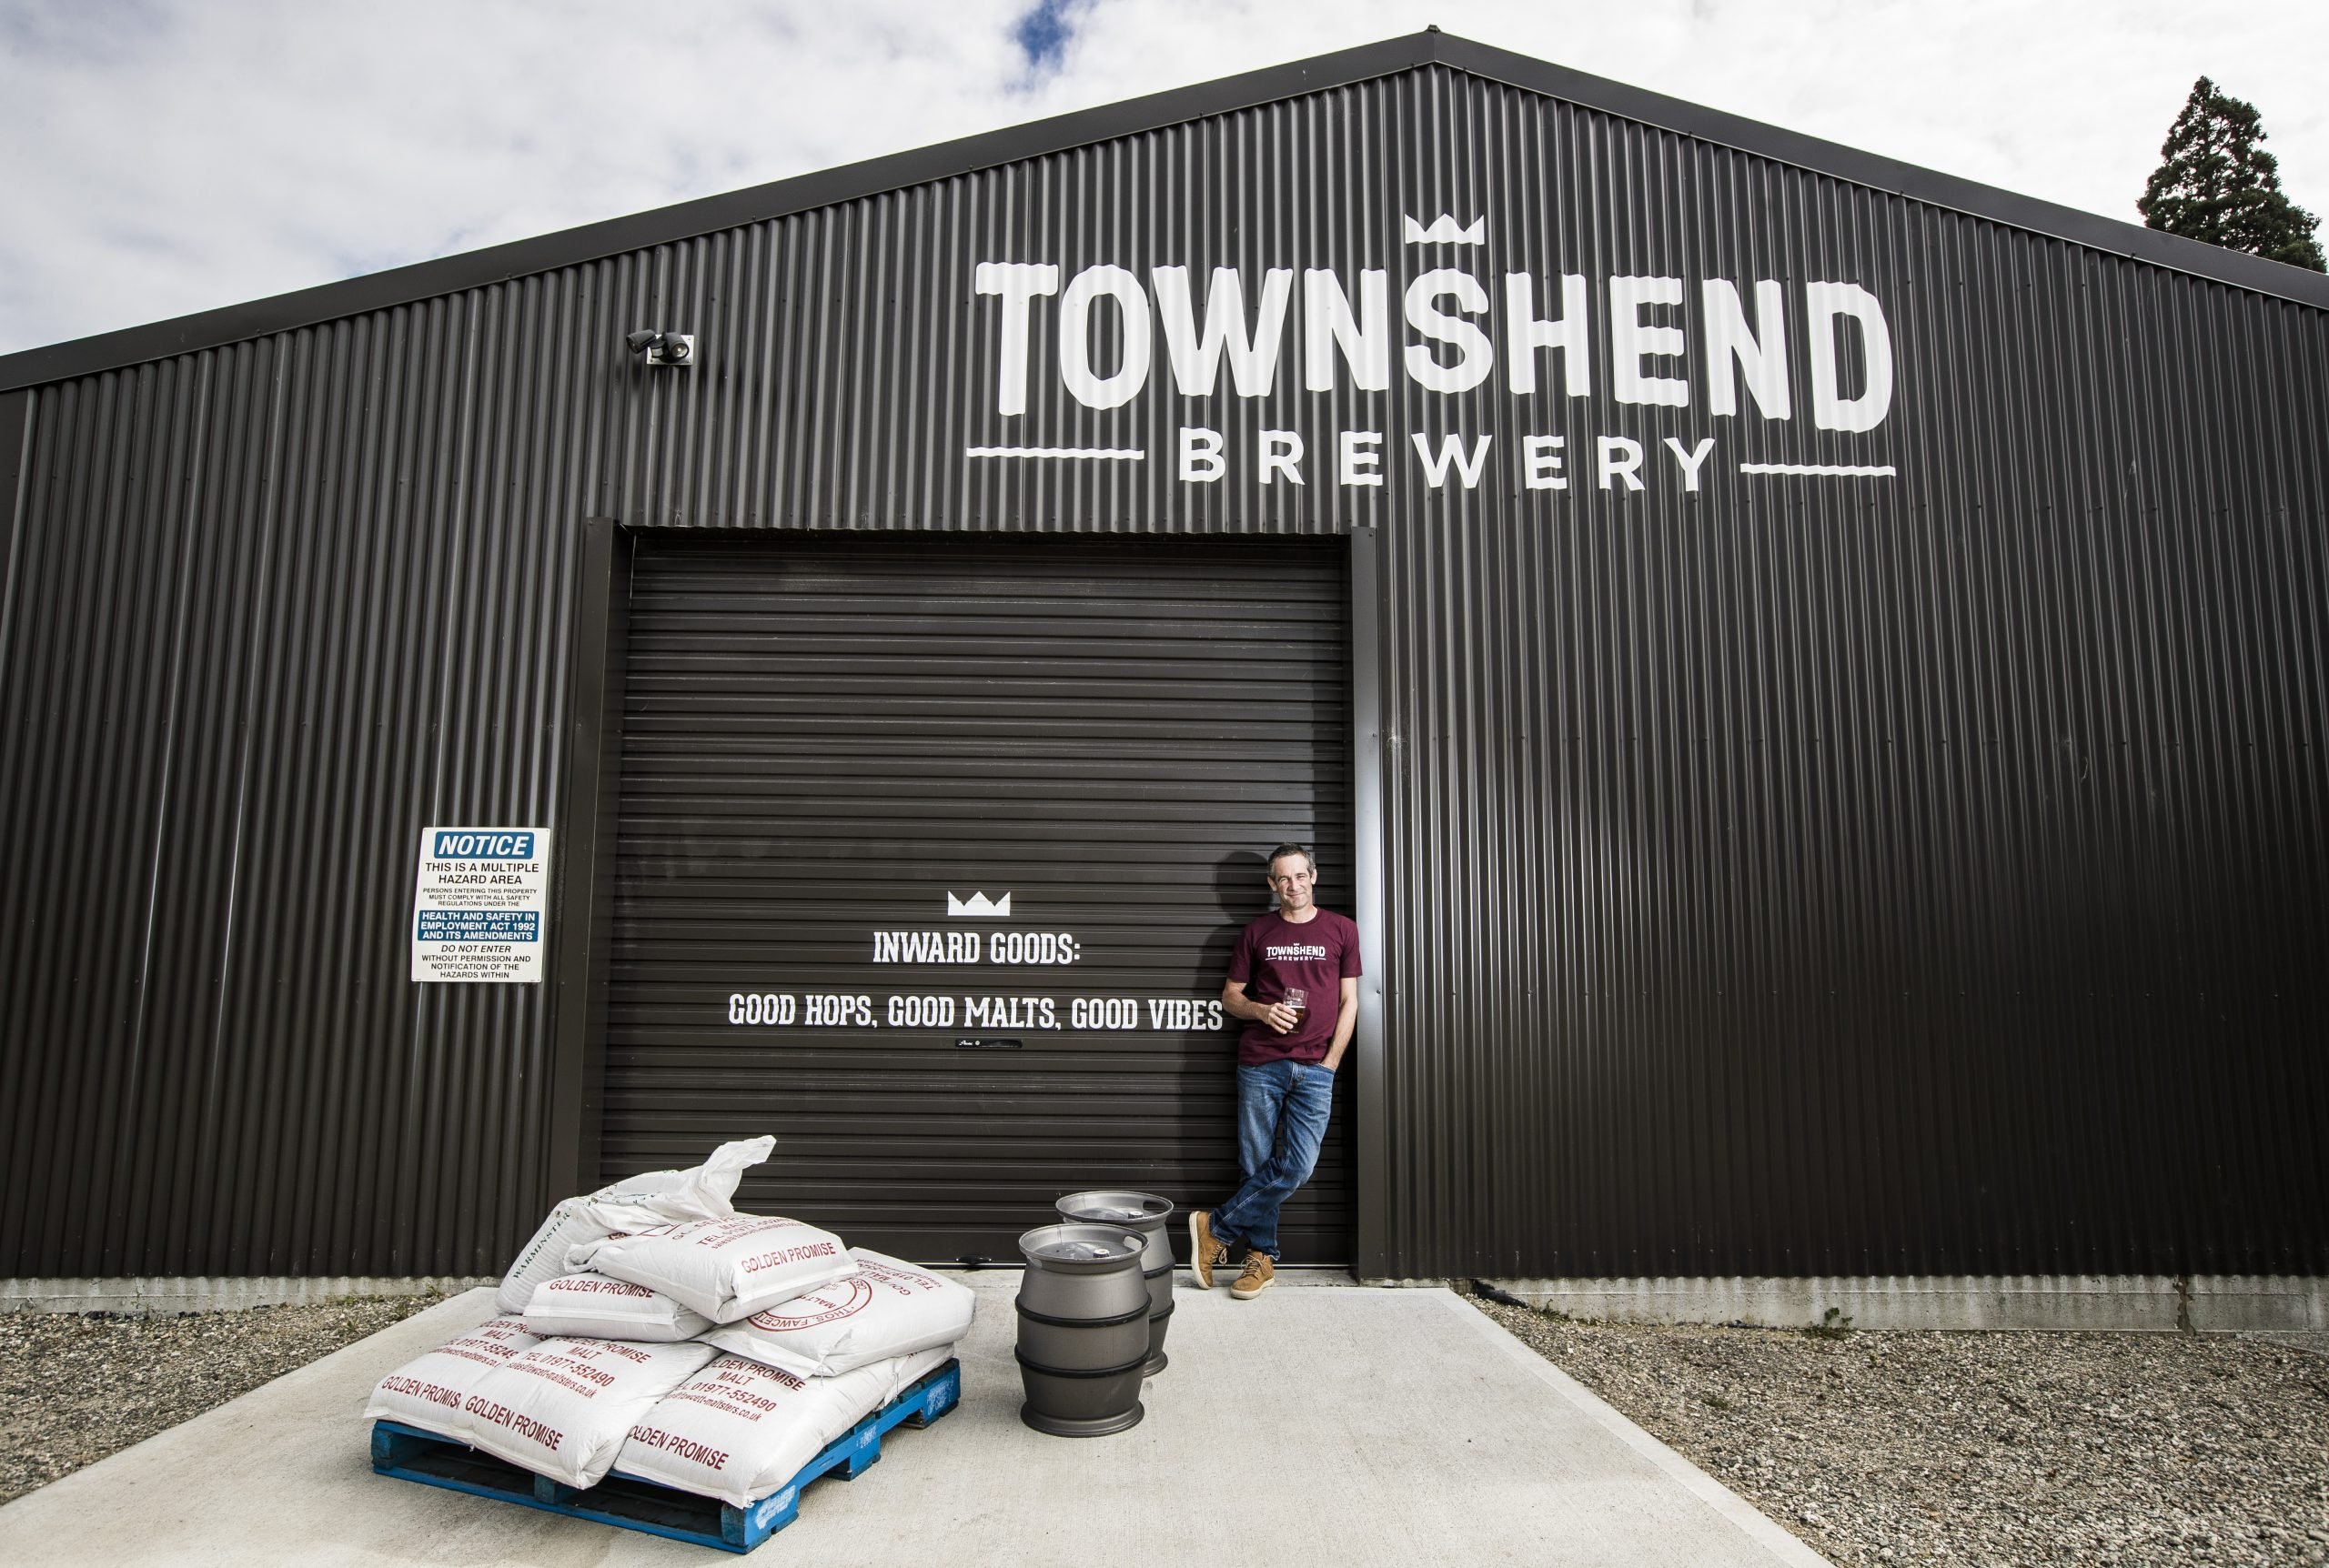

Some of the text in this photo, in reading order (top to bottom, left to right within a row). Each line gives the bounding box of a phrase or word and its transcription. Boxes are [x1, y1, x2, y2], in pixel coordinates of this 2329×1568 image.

[975, 261, 1894, 435] TOWNSHEND
[1178, 427, 1716, 493] BREWERY
[438, 835, 529, 857] NOTICE
[425, 862, 539, 873] THIS IS A MULTIPLE
[439, 875, 522, 885] HAZARD AREA
[420, 922, 535, 930] EMPLOYMENT ACT 1992
[422, 912, 535, 921] HEALTH AND SAFETY IN
[423, 931, 533, 940] AND ITS AMENDMENTS
[872, 931, 1082, 965] INWARD GOODS:
[1265, 945, 1326, 958] TOWNSHEND
[728, 993, 1224, 1031] GOOD HOPS, GOOD MALTS, GOOD VIBES
[512, 1212, 570, 1279] WARMINSTER
[741, 1242, 836, 1273] GOLDEN PROMISE
[549, 1280, 655, 1298] GOLDEN PROMISE
[753, 1313, 808, 1328] FAWCETT
[481, 1330, 515, 1341] MALT
[566, 1346, 602, 1361] MALT
[522, 1352, 615, 1387] TEL 01977-552490
[716, 1371, 754, 1386] MALT
[745, 1364, 806, 1392] PROMISE
[381, 1376, 462, 1410] GOLDEN PROMIS
[691, 1382, 777, 1412] 01977-552490
[465, 1395, 564, 1451] GOLDEN PROMISE
[666, 1436, 730, 1471] PROMISE
